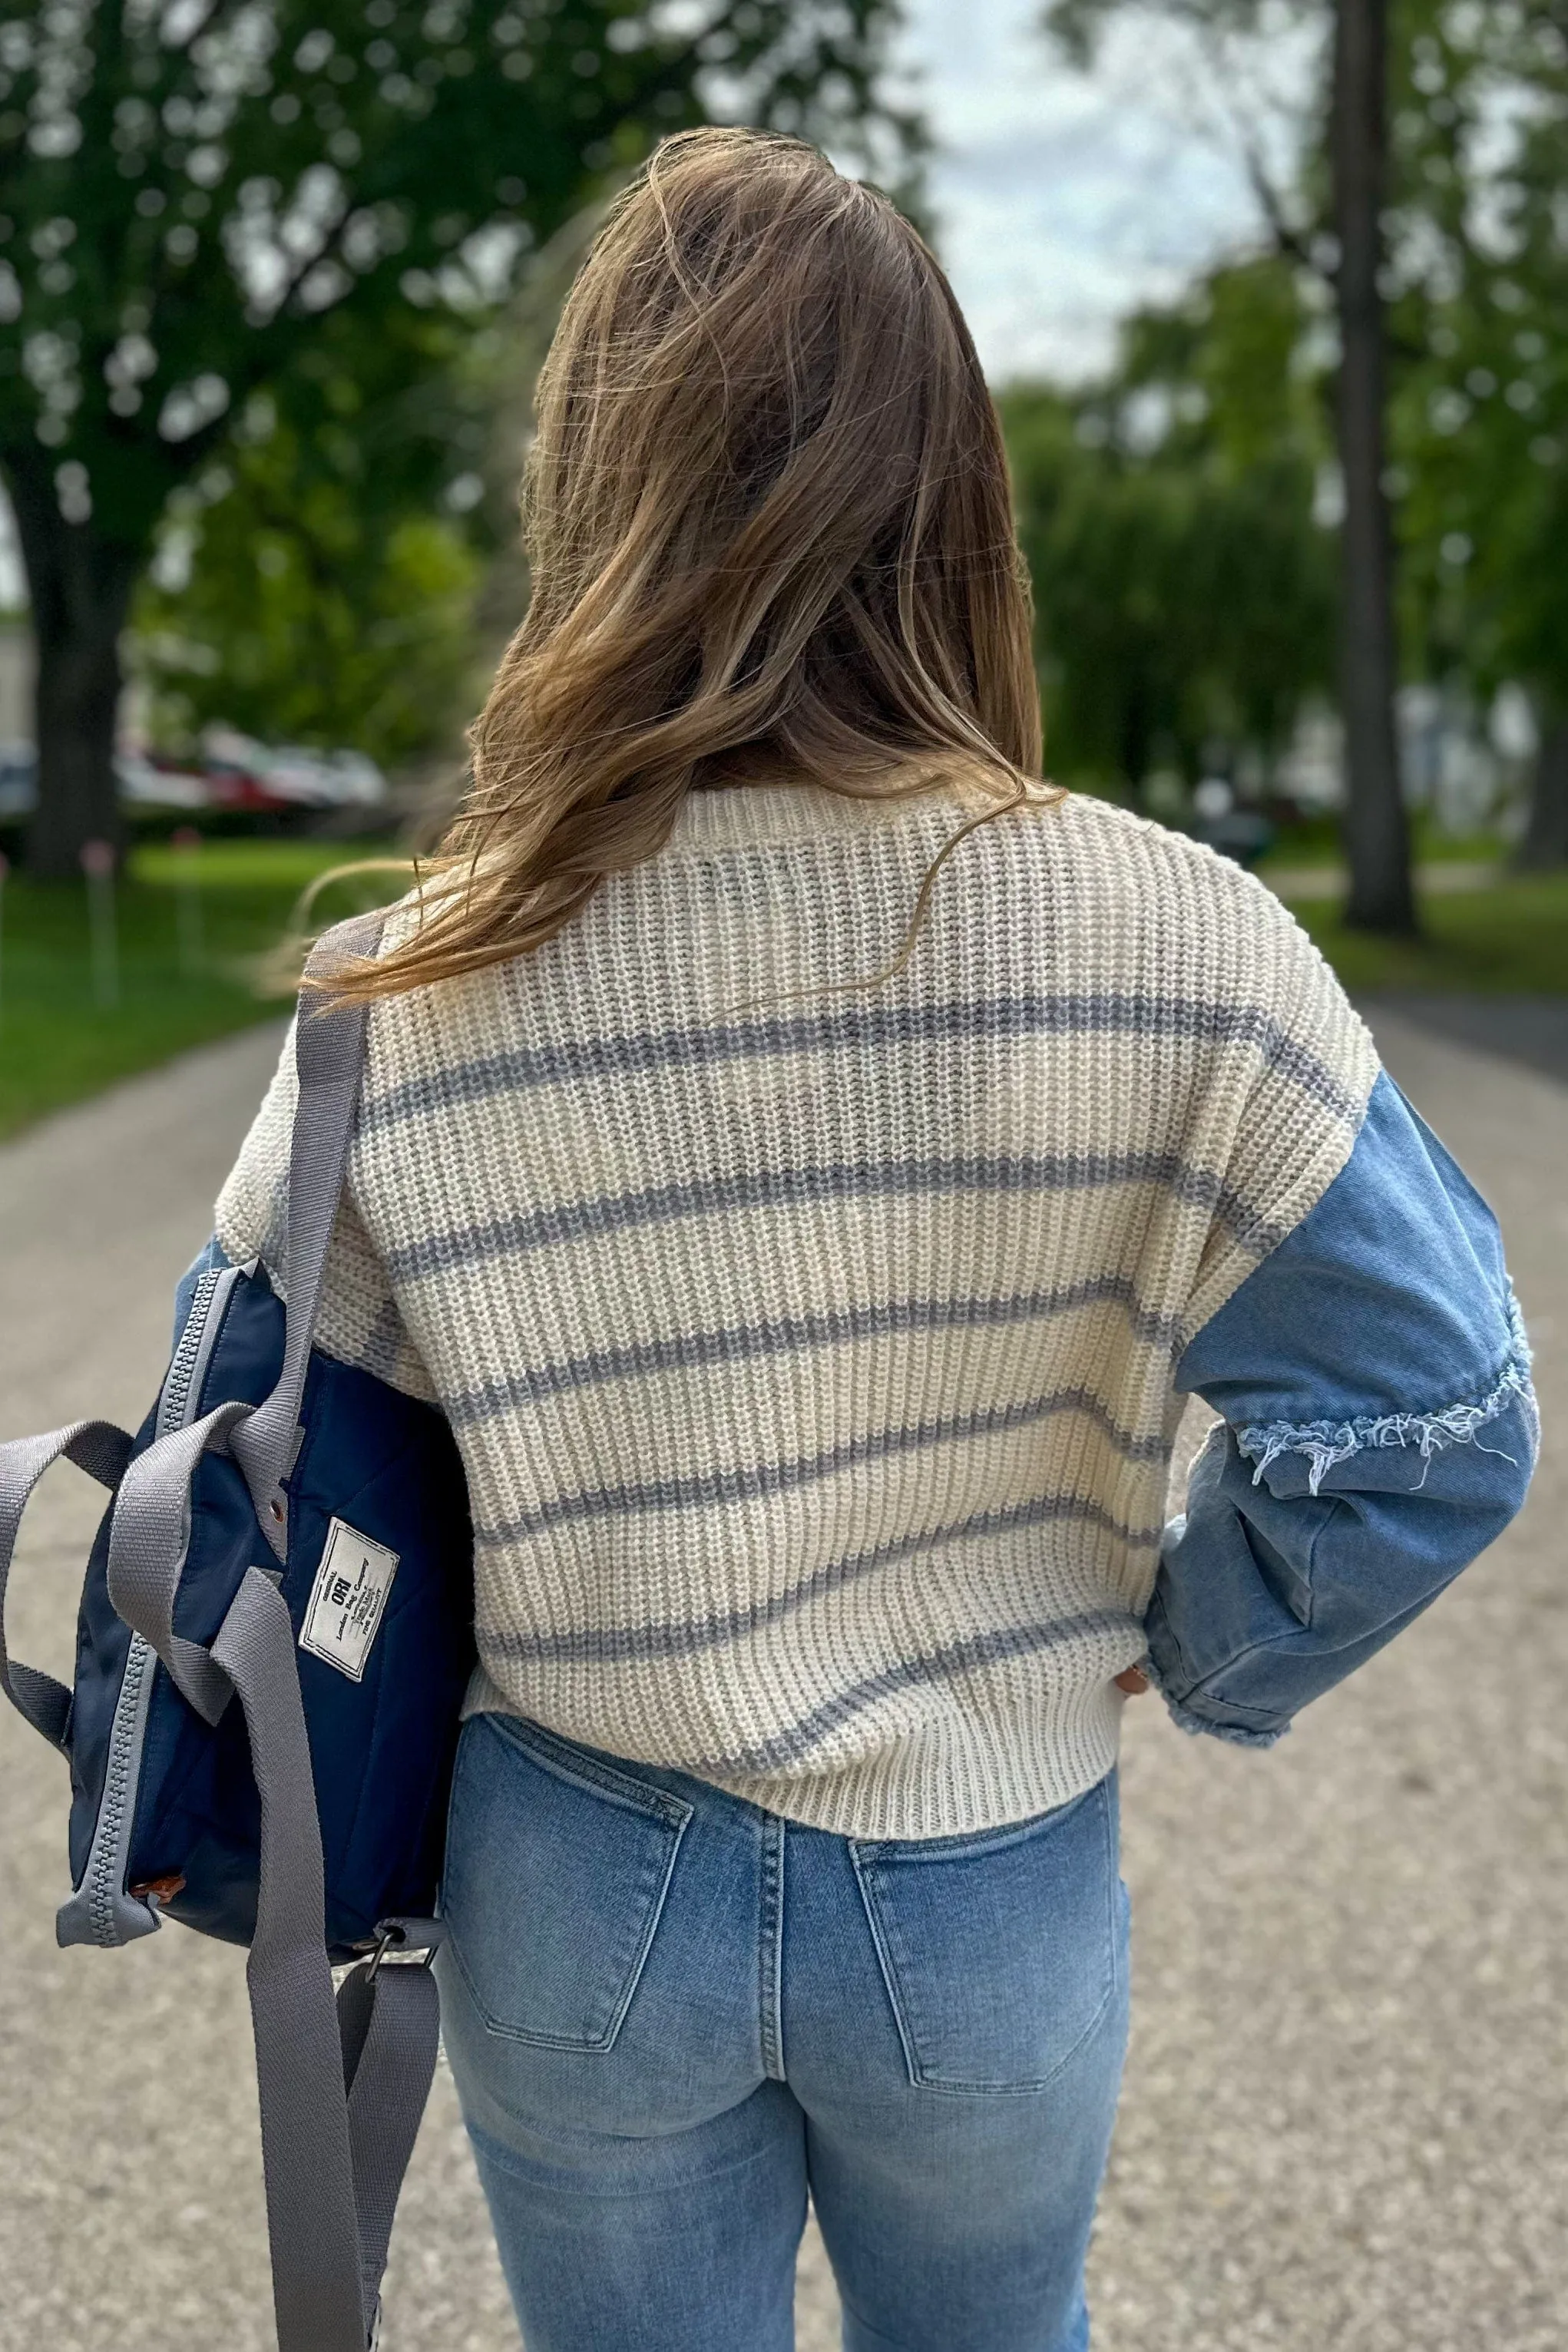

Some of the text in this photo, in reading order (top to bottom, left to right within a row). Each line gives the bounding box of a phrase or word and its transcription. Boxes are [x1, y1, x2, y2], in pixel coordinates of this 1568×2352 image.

[332, 1577, 352, 1606] ORI
[336, 1613, 349, 1642] London
[345, 1595, 357, 1610] Bag
[354, 1558, 369, 1591] Company
[362, 1620, 371, 1636] FINE
[369, 1587, 382, 1618] QUALITY
